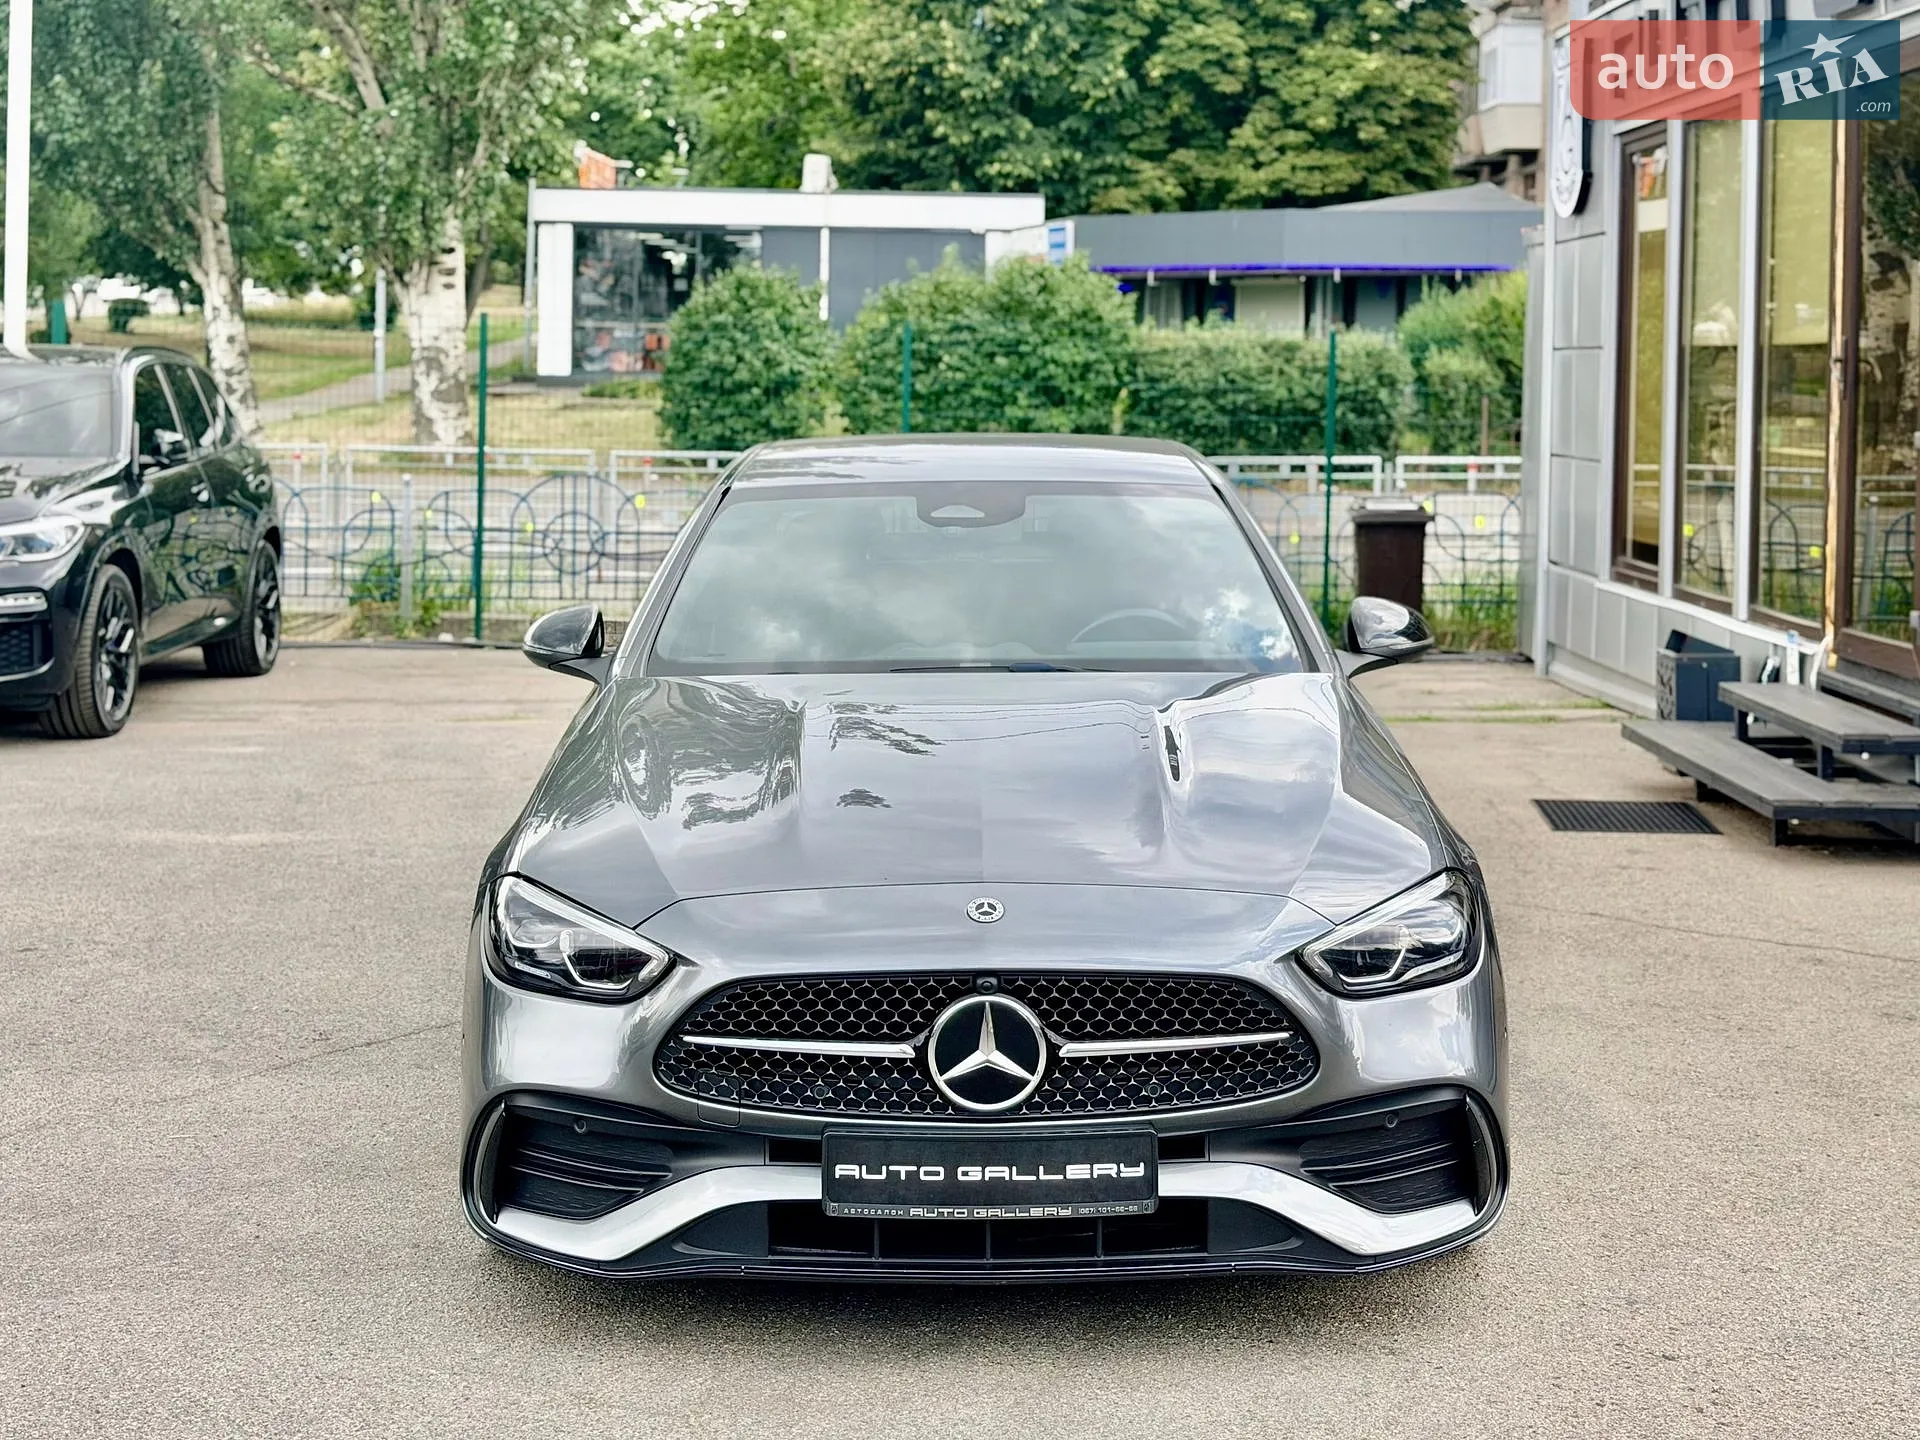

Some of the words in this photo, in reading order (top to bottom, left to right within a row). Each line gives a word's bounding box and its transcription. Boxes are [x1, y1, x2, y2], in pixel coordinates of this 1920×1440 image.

[834, 1164, 945, 1181] AUTO
[957, 1161, 1145, 1181] GALLERY
[909, 1207, 968, 1217] AUTO
[973, 1206, 1072, 1217] GALLERY
